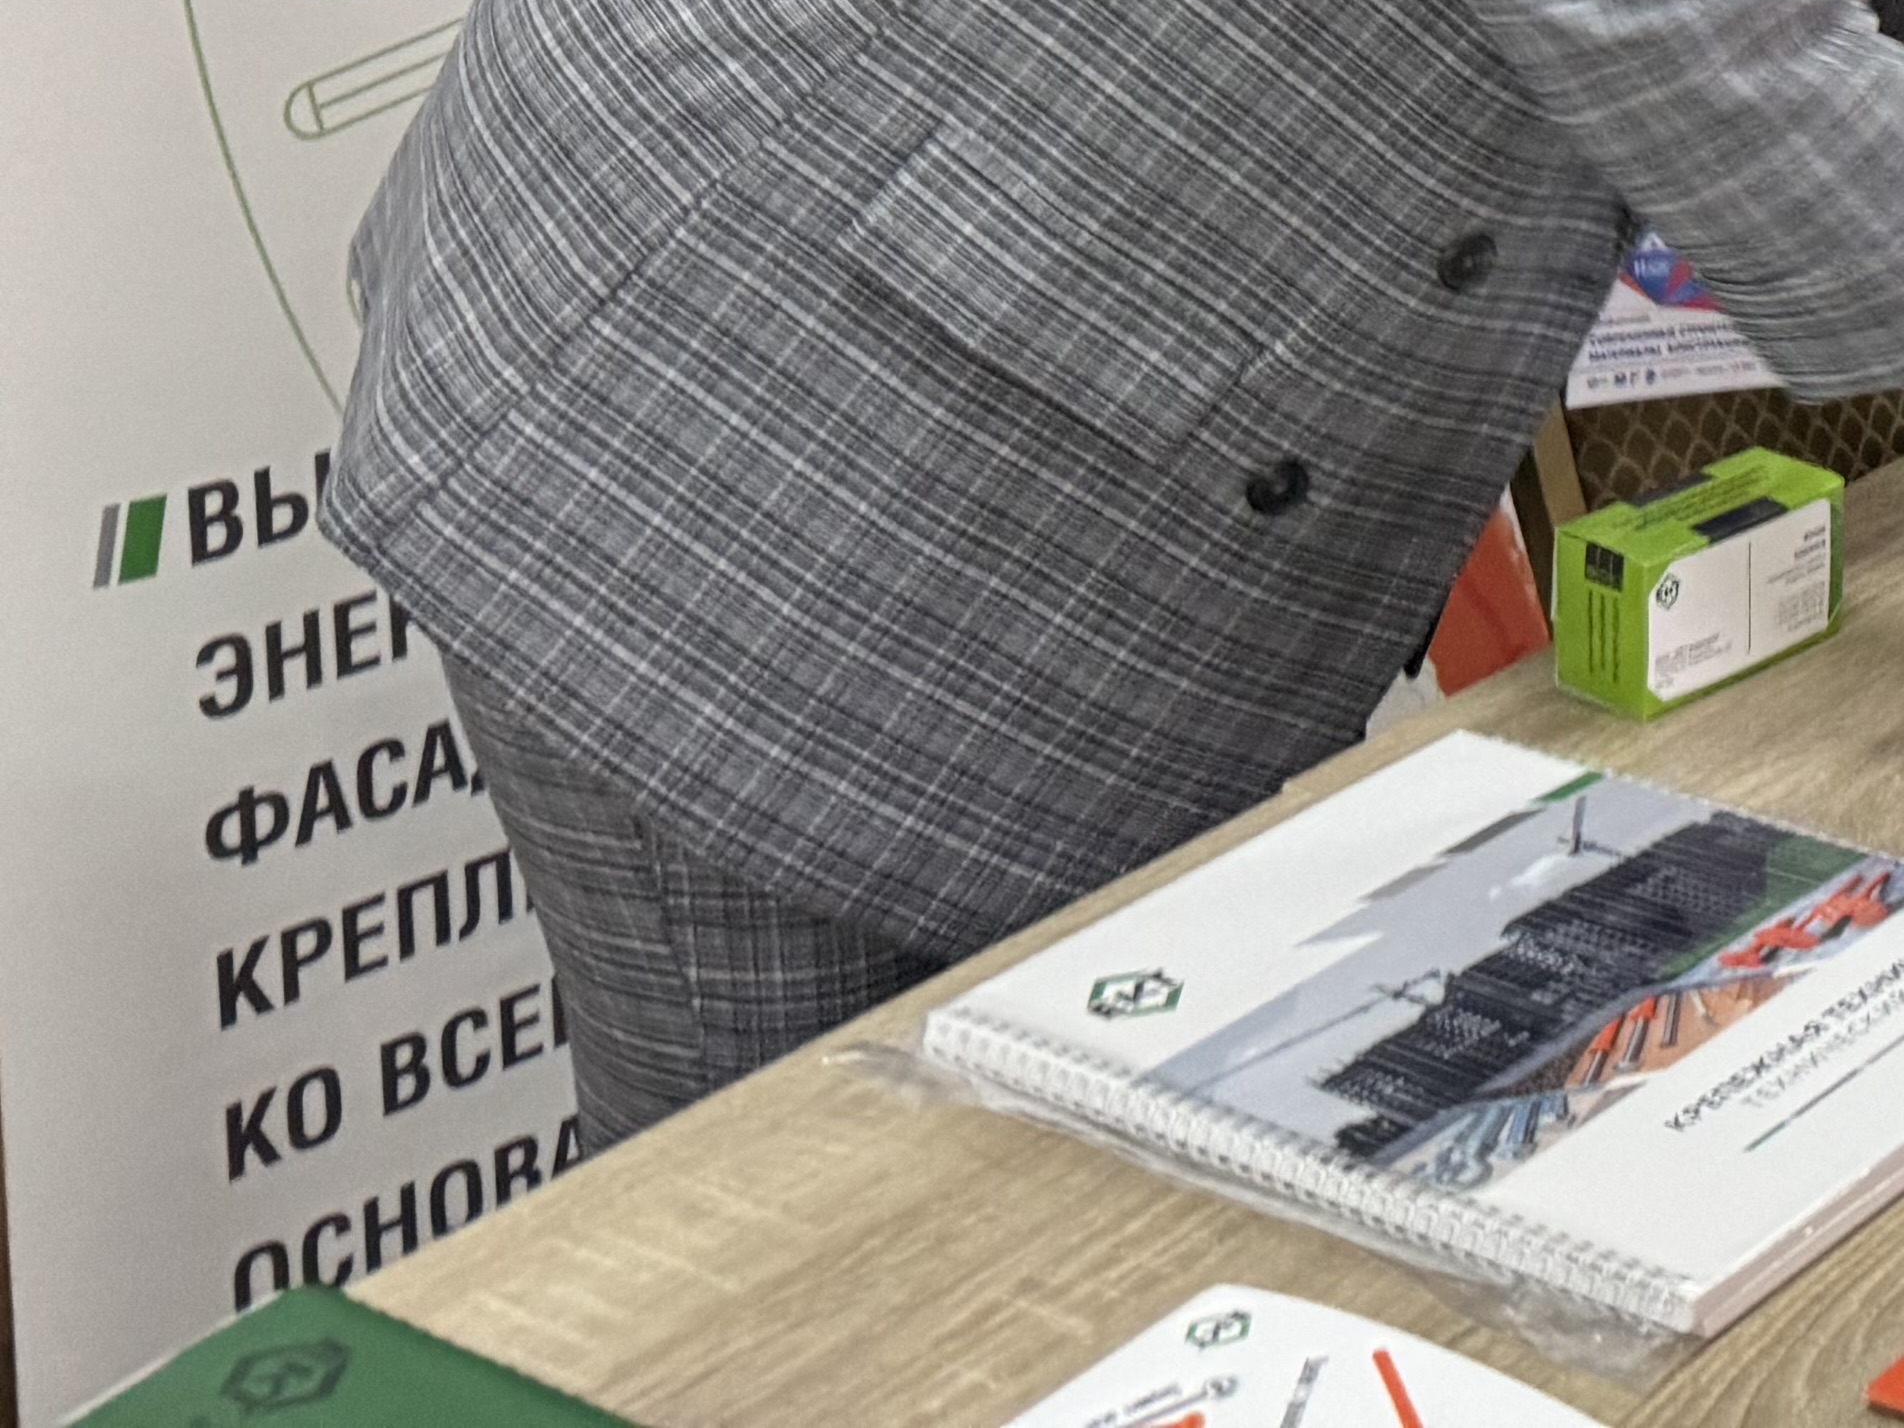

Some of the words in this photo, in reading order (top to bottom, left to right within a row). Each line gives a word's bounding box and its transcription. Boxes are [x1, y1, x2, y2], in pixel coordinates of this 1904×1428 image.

[204, 719, 488, 866] ФАСА
[216, 847, 540, 1030] КРЕПЛ
[223, 1066, 343, 1184] КО
